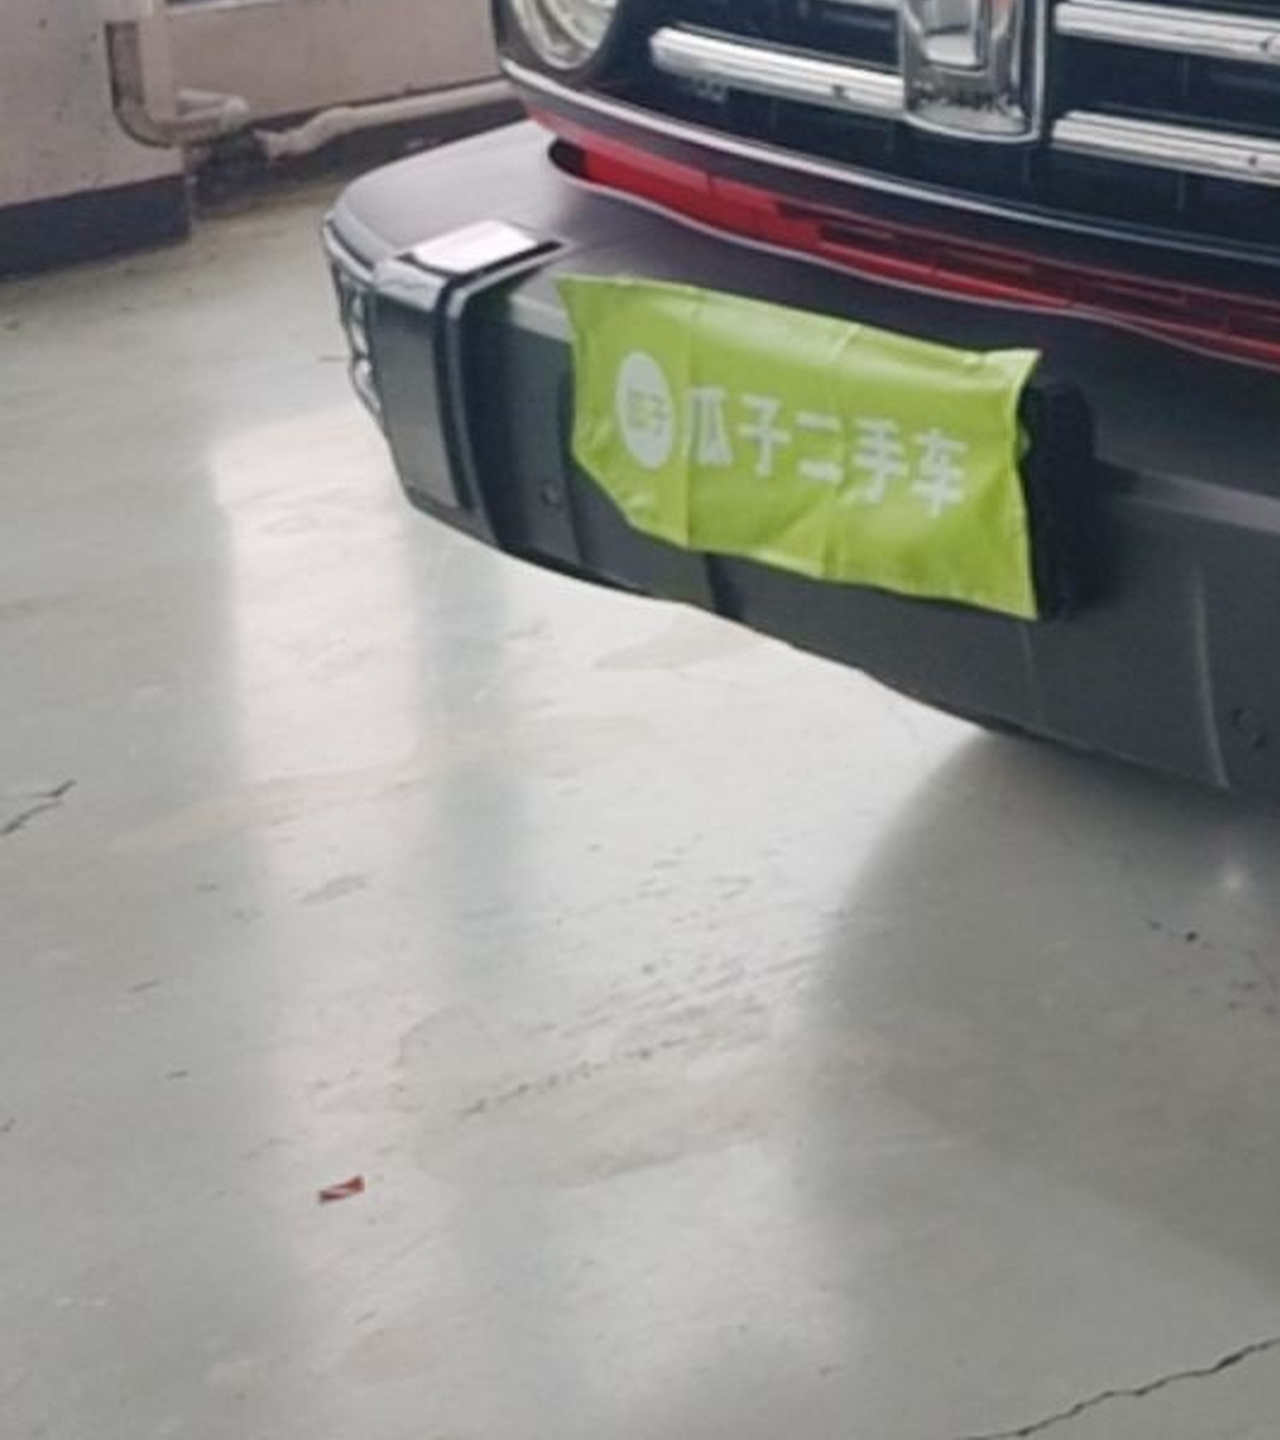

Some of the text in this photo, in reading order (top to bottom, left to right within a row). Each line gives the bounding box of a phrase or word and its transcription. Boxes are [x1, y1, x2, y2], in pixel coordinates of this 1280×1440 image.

[684, 386, 967, 518] 瓜子二手车
